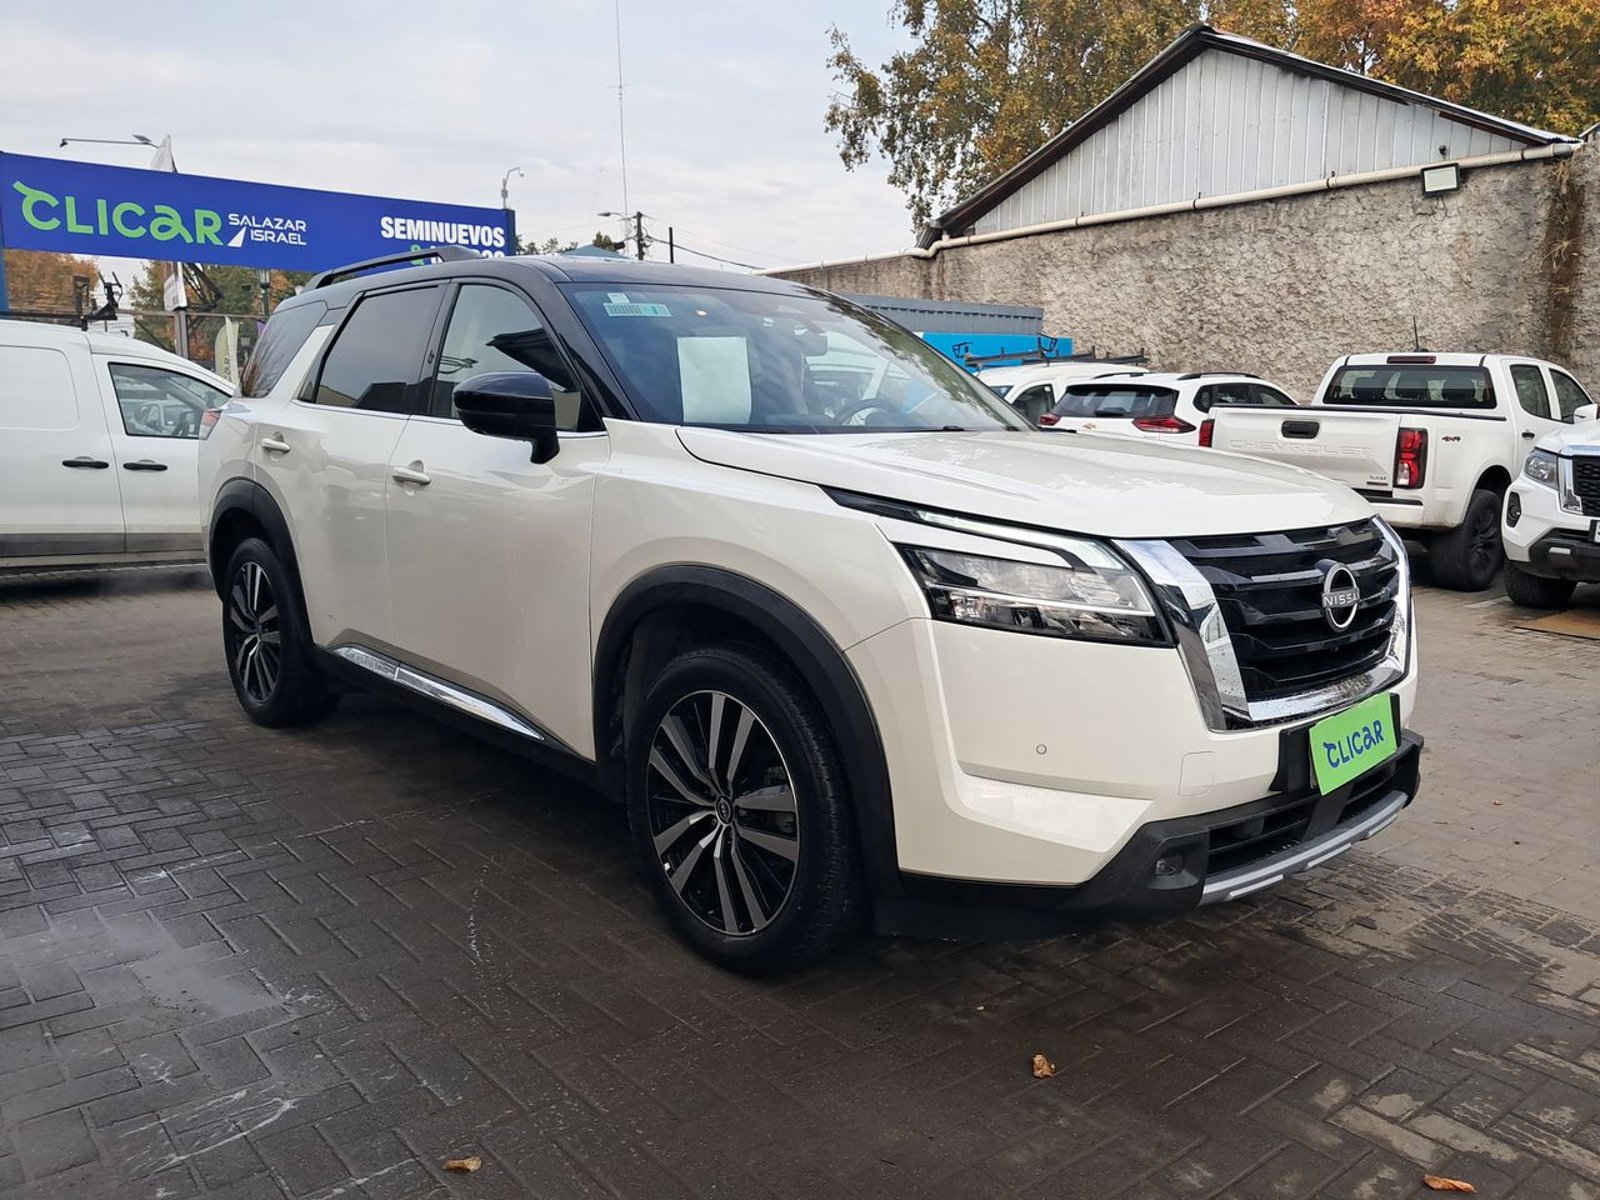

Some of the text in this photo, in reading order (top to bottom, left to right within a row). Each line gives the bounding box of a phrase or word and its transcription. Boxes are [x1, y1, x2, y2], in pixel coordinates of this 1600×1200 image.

[228, 213, 307, 232] SALAZAR
[250, 229, 307, 246] ISRAEL
[380, 216, 505, 248] SEMINUEVOS
[1230, 439, 1370, 457] CHEVROLET
